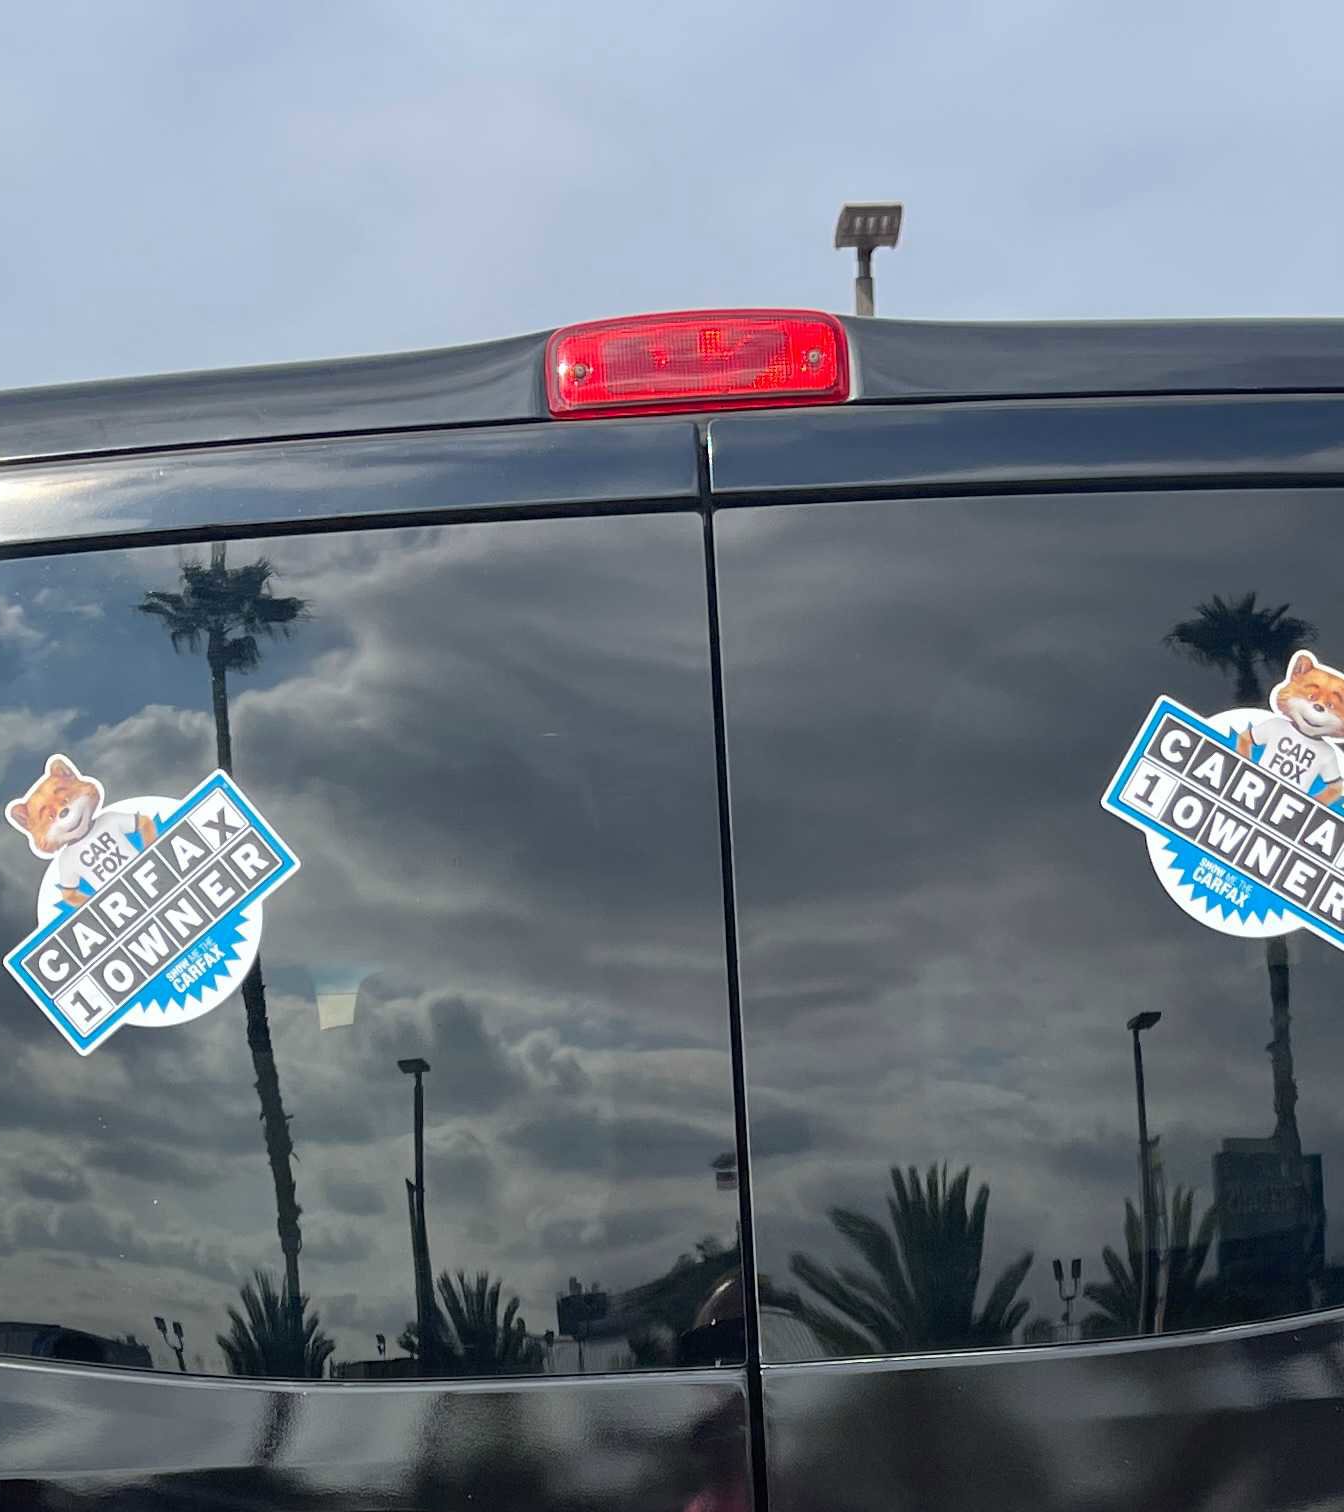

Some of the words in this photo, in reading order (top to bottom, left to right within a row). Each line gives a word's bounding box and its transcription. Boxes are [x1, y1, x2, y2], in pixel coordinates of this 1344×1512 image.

[1269, 757, 1307, 784] FOX
[1277, 736, 1317, 770] CAR
[1134, 774, 1161, 808] 1
[80, 832, 117, 867] CAR
[93, 848, 128, 881] FOX
[38, 807, 240, 983] CARFAX
[1192, 867, 1250, 908] CARFAX
[70, 991, 103, 1022] 1
[103, 843, 271, 992] OWNER
[172, 944, 226, 993] CARFAX
